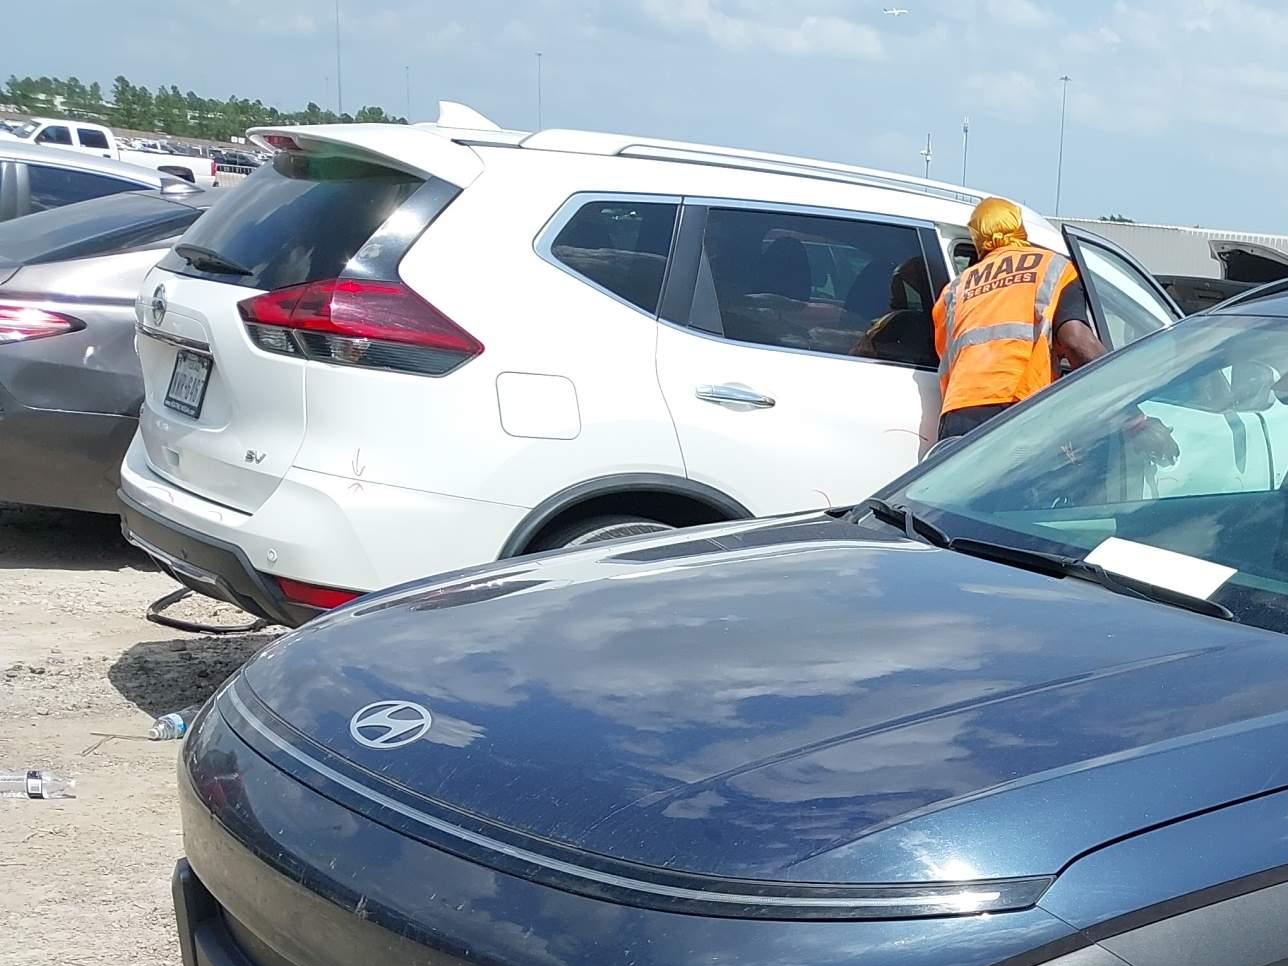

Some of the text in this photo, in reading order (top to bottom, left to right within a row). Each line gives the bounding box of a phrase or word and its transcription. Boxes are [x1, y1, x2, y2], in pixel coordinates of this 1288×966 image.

[964, 253, 1043, 291] MAD
[966, 273, 1033, 299] SERVICES
[245, 450, 266, 464] SV
